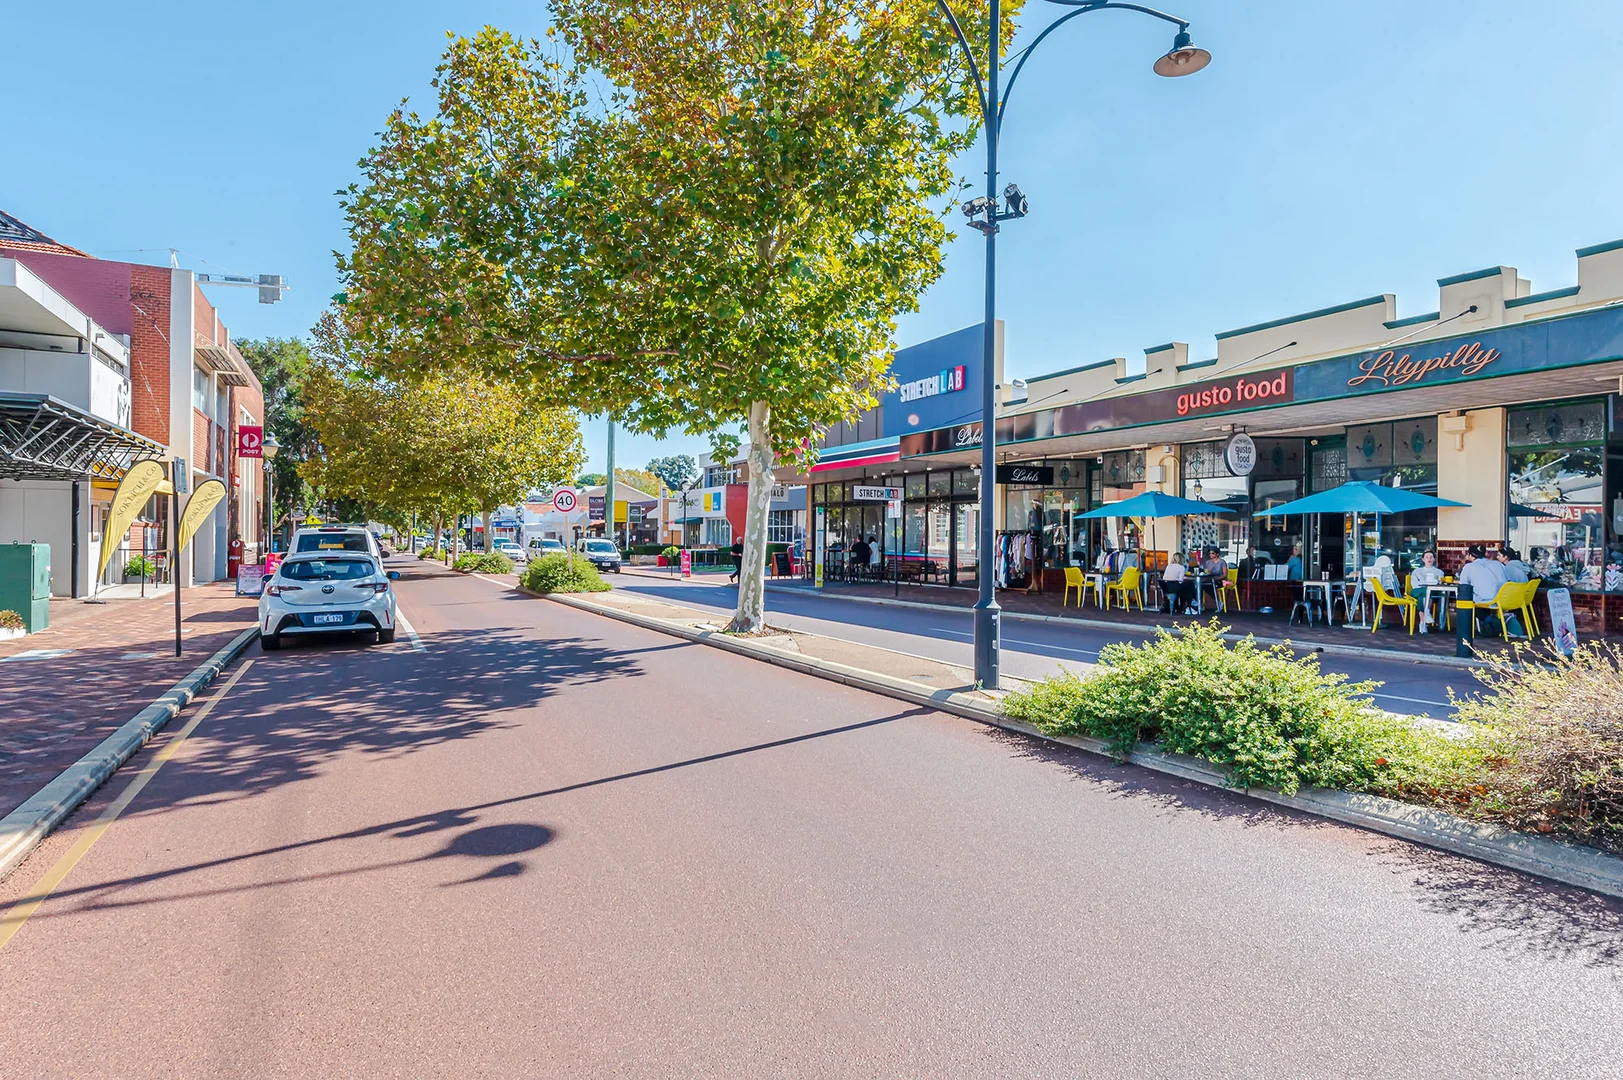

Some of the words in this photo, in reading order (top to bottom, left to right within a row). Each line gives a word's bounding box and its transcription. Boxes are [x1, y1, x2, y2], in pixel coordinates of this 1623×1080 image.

[1347, 341, 1501, 386] Lilypilly
[1176, 385, 1232, 415] gusto
[1236, 372, 1287, 401] food
[1234, 446, 1251, 454] gusto
[1237, 453, 1250, 462] food
[1011, 468, 1039, 482] Labels
[557, 496, 573, 505] 40
